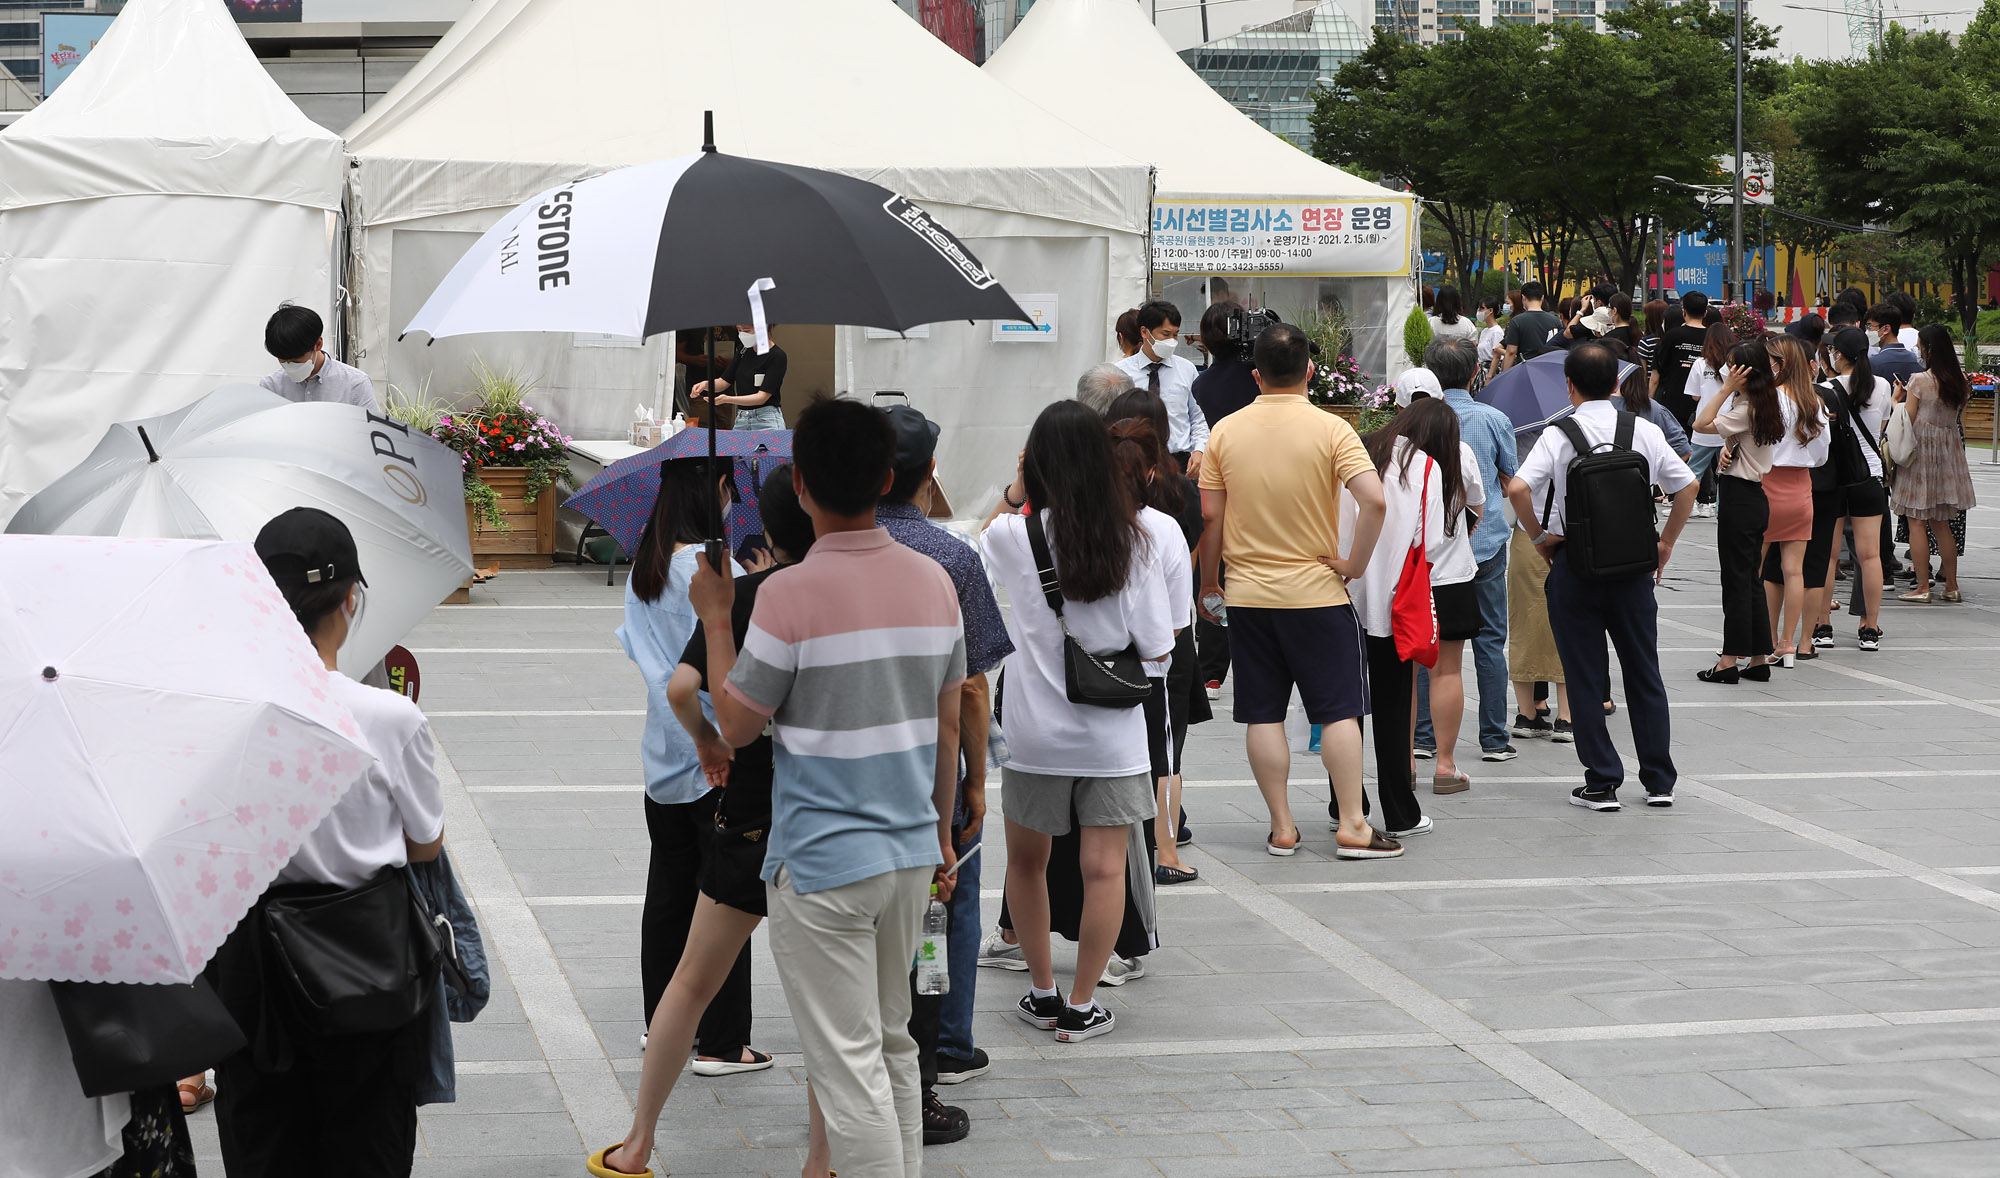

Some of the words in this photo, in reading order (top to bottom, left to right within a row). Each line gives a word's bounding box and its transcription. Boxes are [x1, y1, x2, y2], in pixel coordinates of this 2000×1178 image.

[900, 206, 924, 223] PGA
[1302, 207, 1344, 232] 연장
[1351, 206, 1392, 231] 운영
[1218, 236, 1255, 246] 254-3)]
[1272, 235, 1310, 247] 운영기간
[1318, 234, 1342, 245] 2021.
[911, 216, 987, 283] TOUR
[1163, 248, 1220, 258] 12:00~13:00
[1227, 249, 1253, 259] [주말]
[1255, 248, 1312, 258] 09:00~14:00
[1216, 262, 1284, 271] 02-3423-5555)
